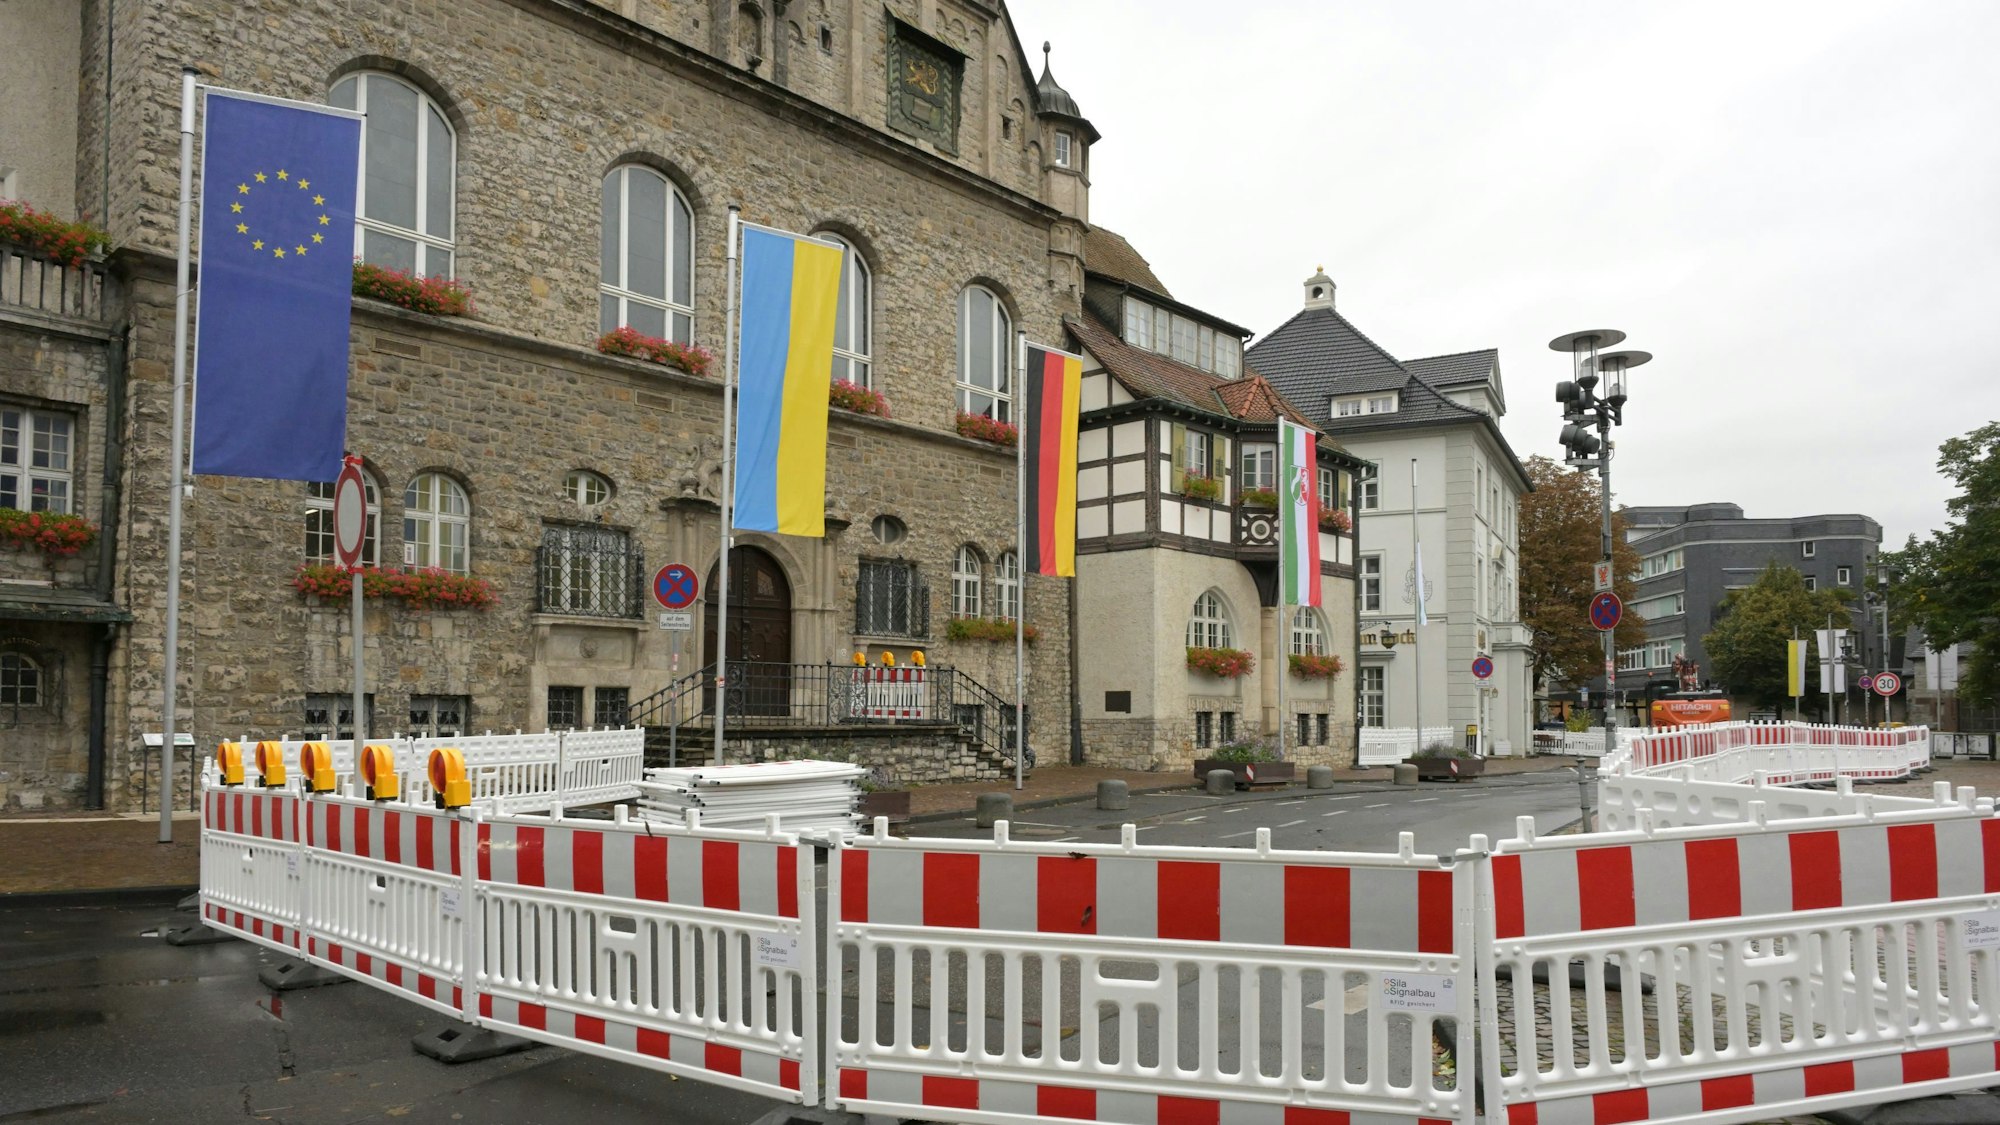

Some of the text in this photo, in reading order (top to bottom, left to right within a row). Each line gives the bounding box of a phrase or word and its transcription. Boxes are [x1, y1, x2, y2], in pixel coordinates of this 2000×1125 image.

[1879, 678, 1894, 689] 30
[1670, 703, 1712, 711] HITACHI
[1967, 919, 1979, 927] Sila
[1967, 925, 1999, 936] Signalbau
[760, 937, 770, 946] Sila
[760, 944, 788, 955] Signalbau
[1389, 978, 1407, 988] Sila
[1389, 987, 1436, 998] Signalbau
